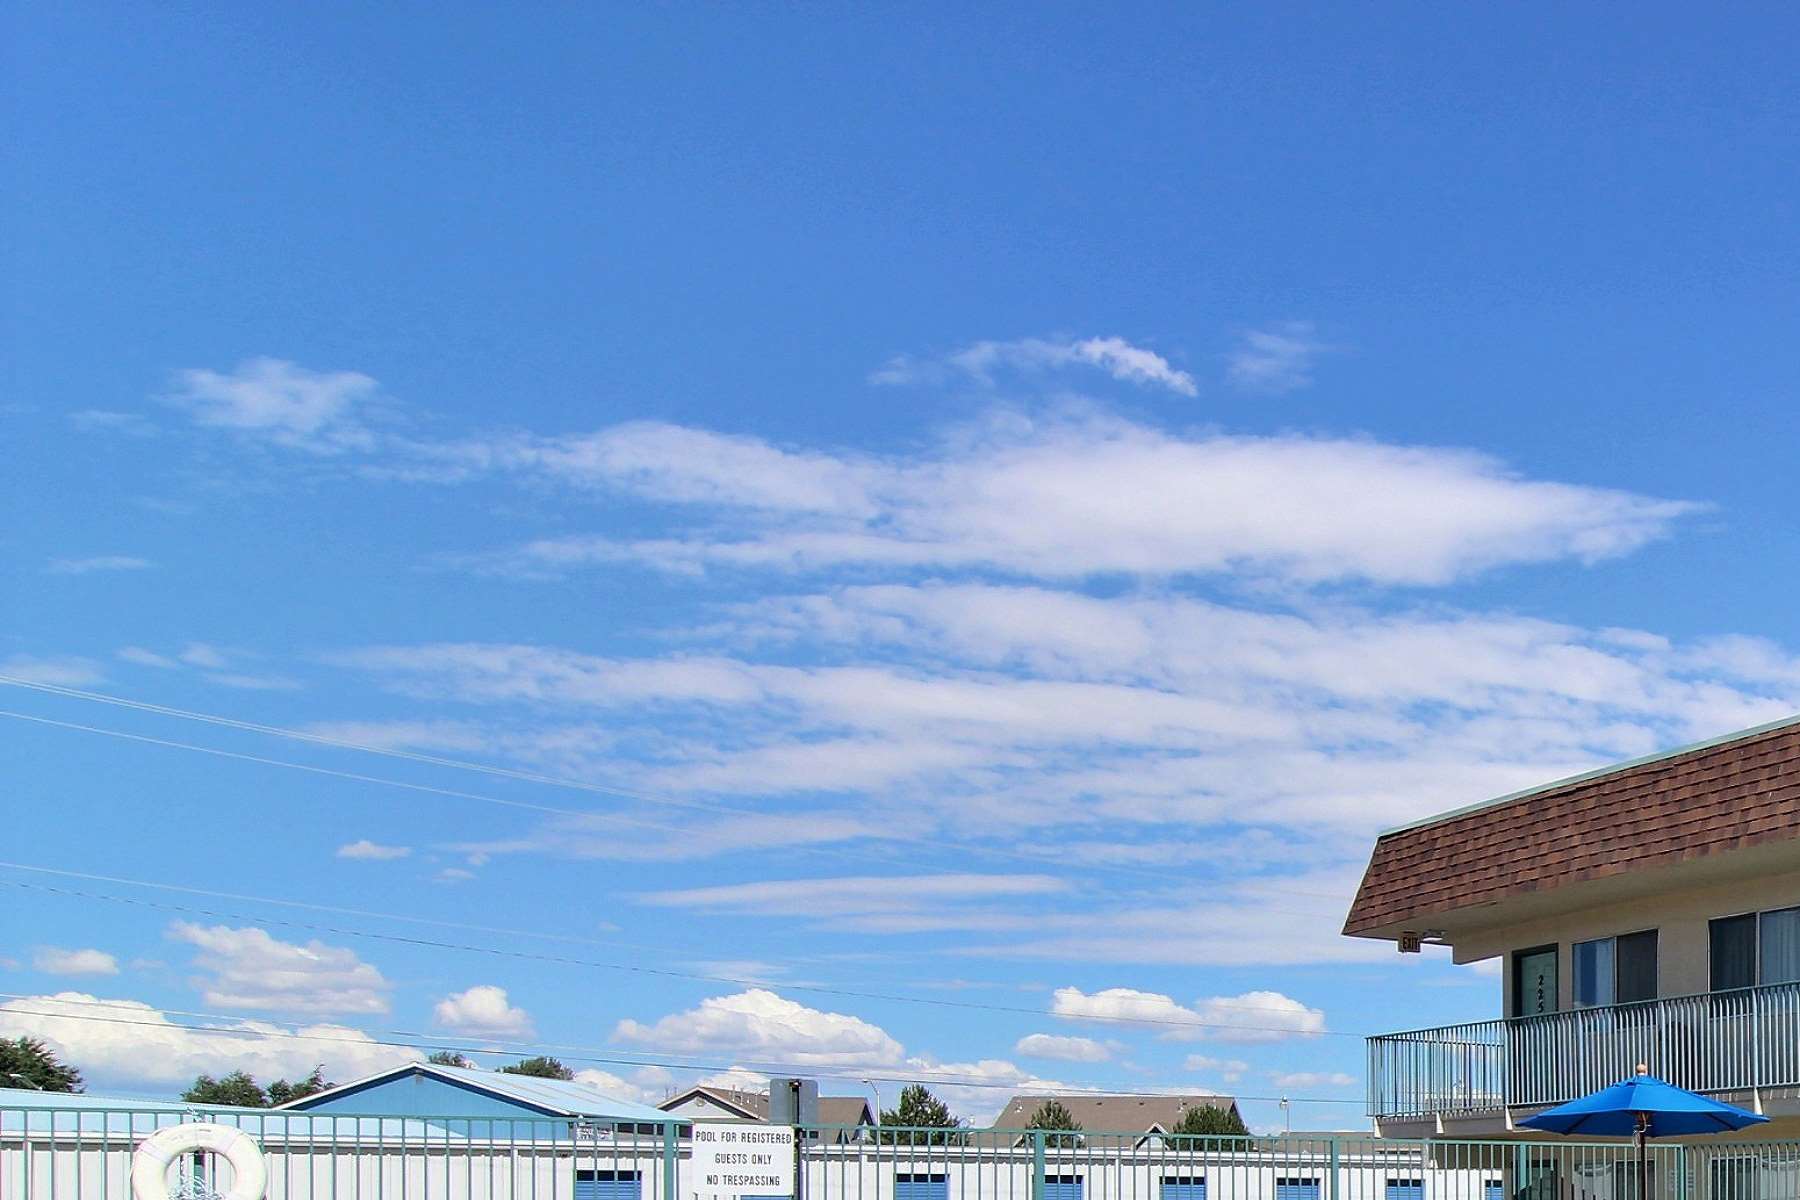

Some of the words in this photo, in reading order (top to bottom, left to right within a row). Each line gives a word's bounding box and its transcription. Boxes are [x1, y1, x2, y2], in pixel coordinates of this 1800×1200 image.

[695, 1131, 717, 1142] POOL
[721, 1132, 737, 1143] FOR
[741, 1132, 792, 1144] REGISTERED
[715, 1153, 748, 1164] GUESTS
[751, 1154, 772, 1165] ONLY
[706, 1174, 719, 1185] NO
[723, 1175, 780, 1186] TRESPASSING
